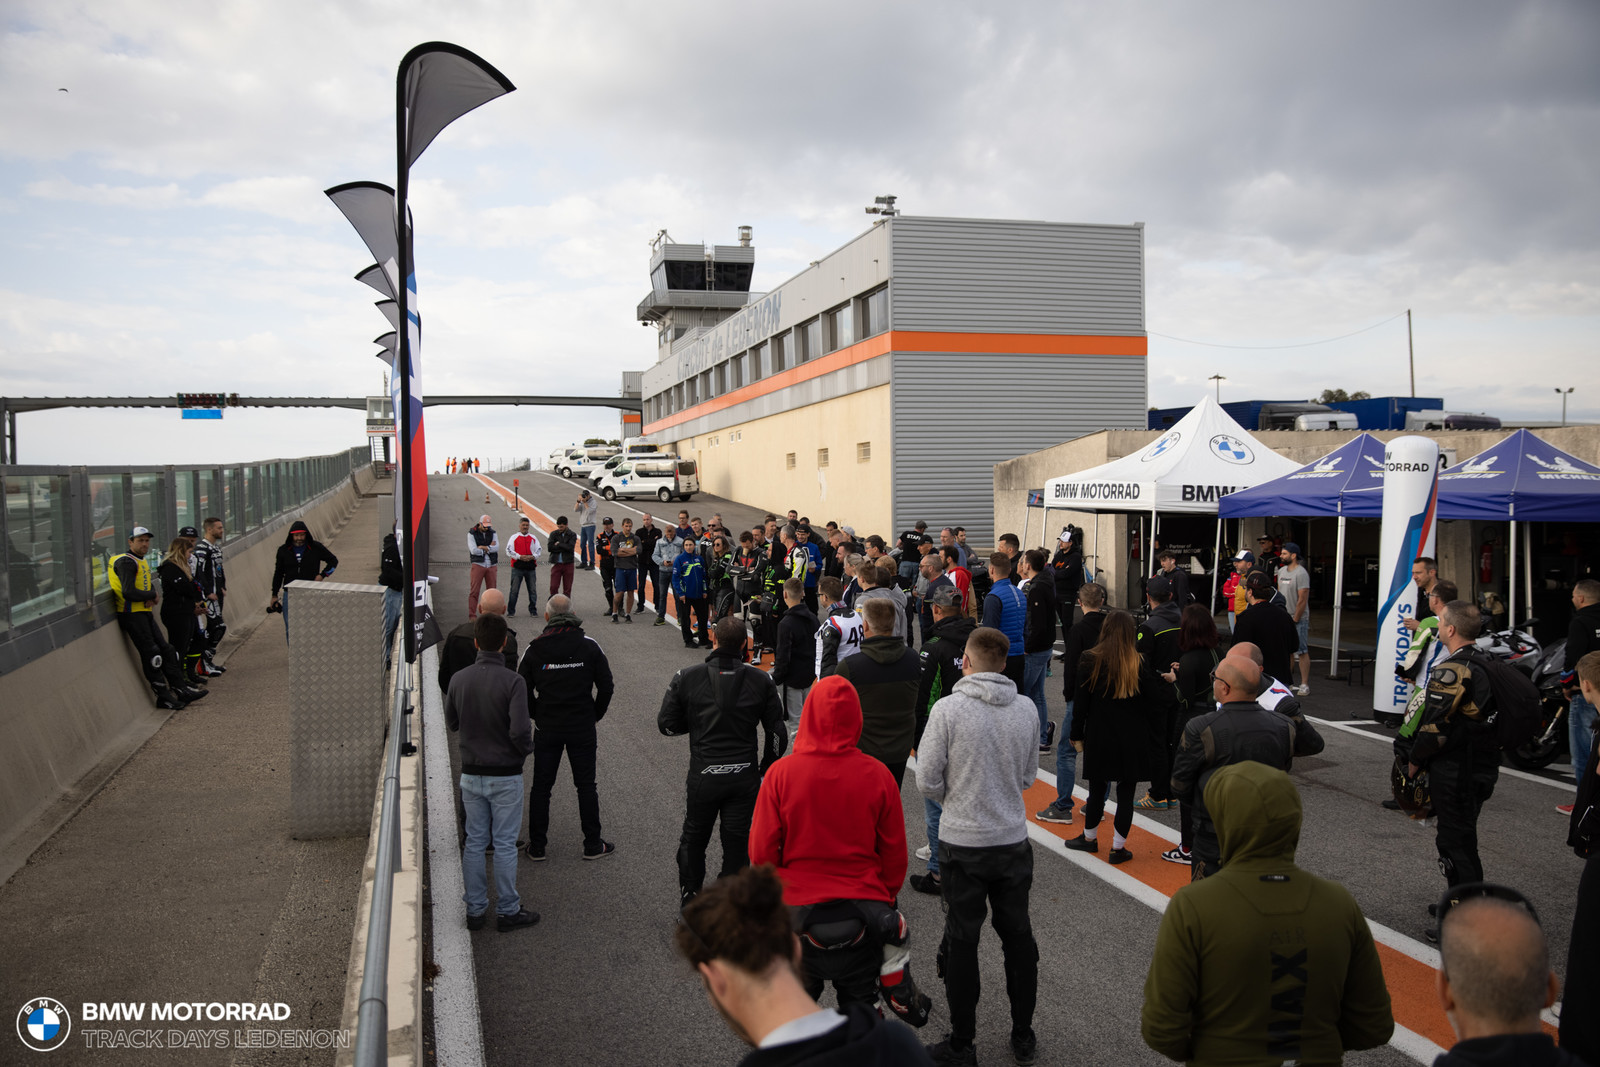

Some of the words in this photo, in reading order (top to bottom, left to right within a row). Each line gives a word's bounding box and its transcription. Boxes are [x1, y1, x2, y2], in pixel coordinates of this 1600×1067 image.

[726, 290, 782, 358] LEDENON
[1055, 483, 1078, 499] BMW
[1080, 483, 1140, 499] MOTORRAD
[1182, 485, 1236, 501] BMW
[847, 626, 864, 648] 48
[1393, 603, 1412, 706] TRAKDAYS
[701, 762, 751, 774] RST
[1269, 926, 1307, 946] AIR
[1267, 948, 1308, 1056] MAX
